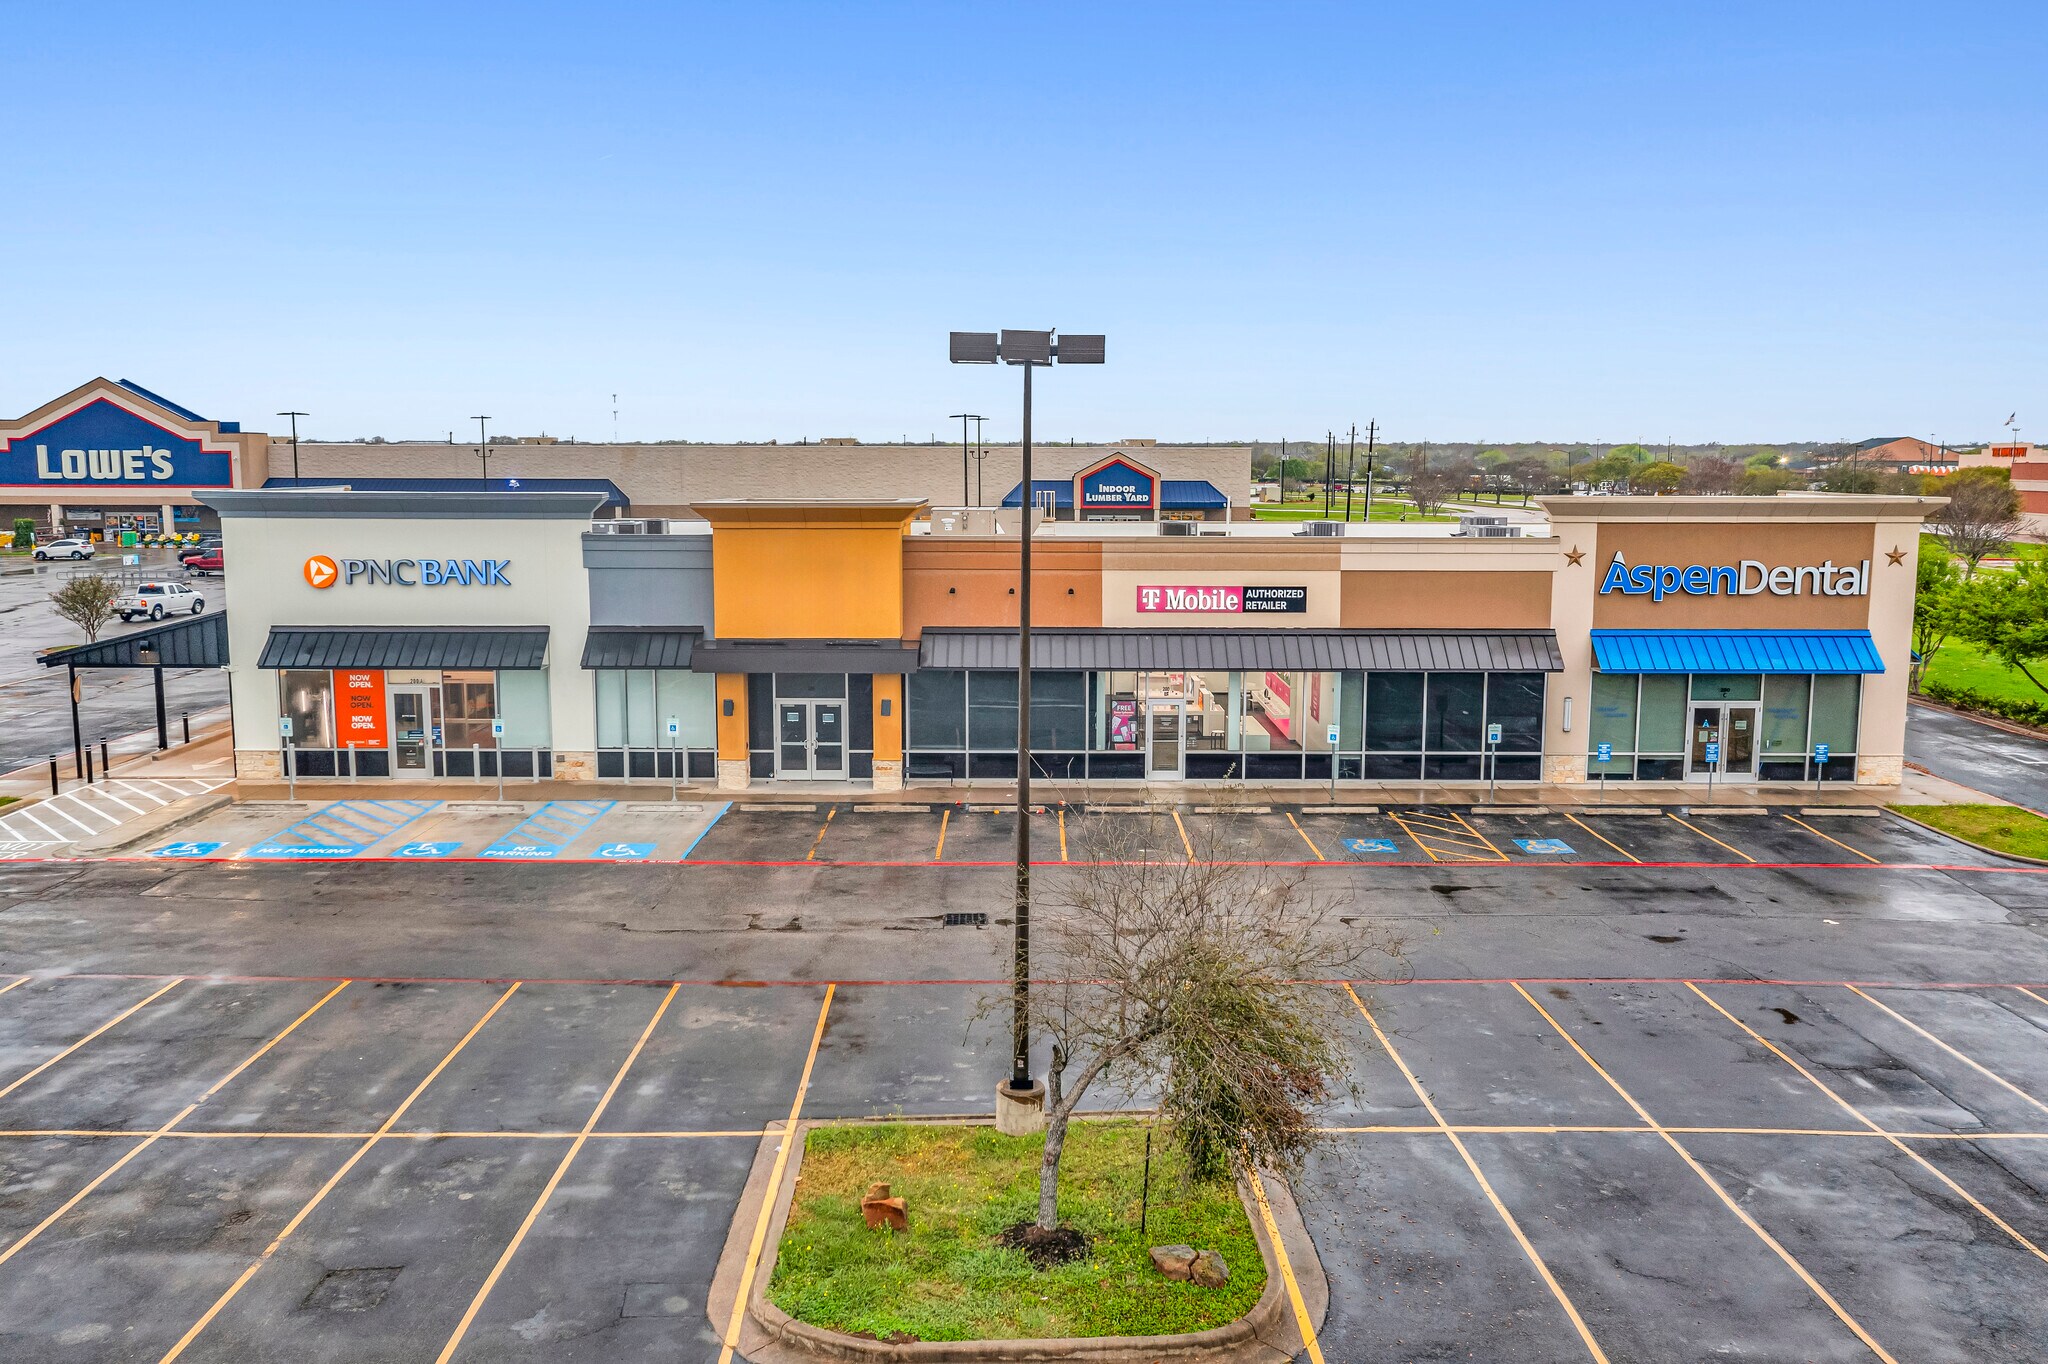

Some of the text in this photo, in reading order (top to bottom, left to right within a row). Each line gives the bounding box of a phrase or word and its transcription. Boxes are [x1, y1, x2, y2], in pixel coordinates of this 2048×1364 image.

[36, 445, 174, 480] LOWE'S
[1099, 484, 1135, 493] INDOOR
[1086, 493, 1149, 502] LUMBER YARD
[1246, 589, 1304, 598] AUTHORIZED
[1165, 588, 1238, 611] Mobile
[1246, 601, 1287, 610] RETAILER
